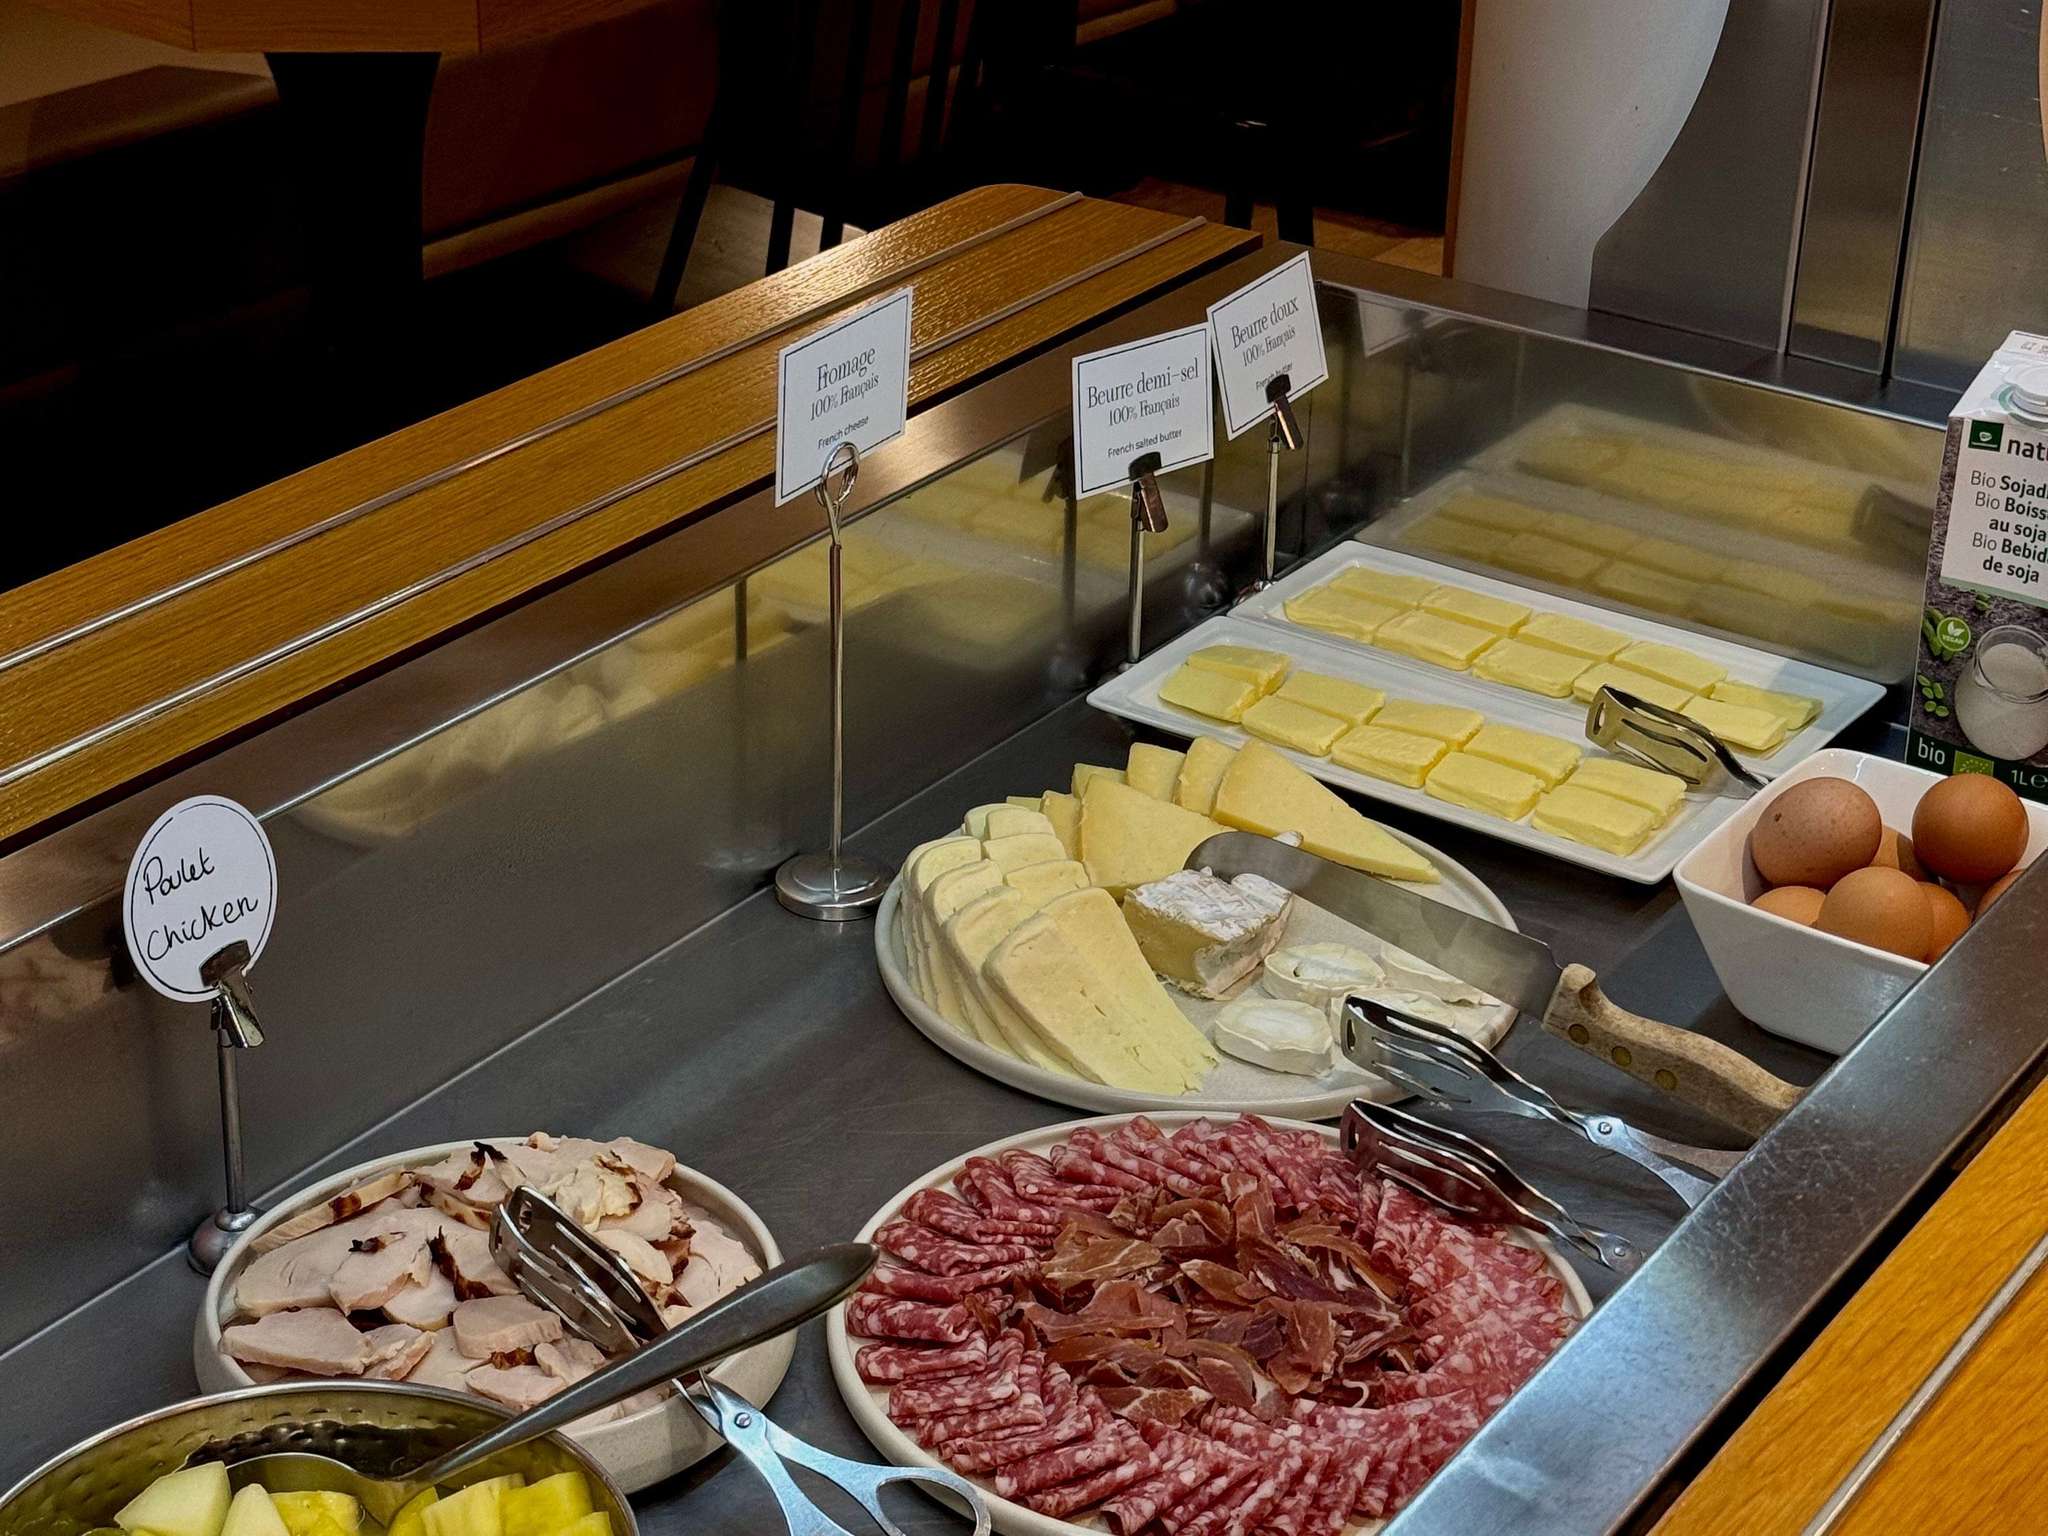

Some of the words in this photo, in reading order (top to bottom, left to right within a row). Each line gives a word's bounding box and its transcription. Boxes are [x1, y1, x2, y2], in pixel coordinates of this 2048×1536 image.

[1231, 315, 1268, 350] Beurre
[1269, 297, 1300, 324] doux
[1242, 343, 1265, 367] 100%
[1264, 325, 1296, 354] Français
[815, 347, 876, 392] Fromage
[1087, 382, 1134, 409] Beurre
[1136, 357, 1199, 394] demi-sel
[809, 393, 839, 421] 100%
[840, 373, 880, 406] Français
[1109, 406, 1139, 427] 100%
[1140, 393, 1180, 418] Français
[817, 429, 843, 449] French
[843, 415, 869, 436] cheese
[1107, 444, 1135, 458] French
[1135, 433, 1159, 450] salted
[1159, 429, 1183, 442] butter
[2007, 439, 2048, 462] nat
[1970, 470, 1996, 489] Bio
[1999, 475, 2048, 499] Sojad
[1975, 490, 2001, 510] Bio
[2004, 497, 2048, 521] Boiss
[1989, 519, 2010, 532] au
[2013, 524, 2047, 544] soja
[1972, 532, 1997, 551] Bio
[2001, 538, 2048, 564] Bebid
[1982, 555, 2003, 573] de
[2006, 564, 2040, 584] soja
[1918, 737, 1945, 765] bio
[2011, 769, 2028, 786] 1L
[147, 896, 258, 961] Chicken
